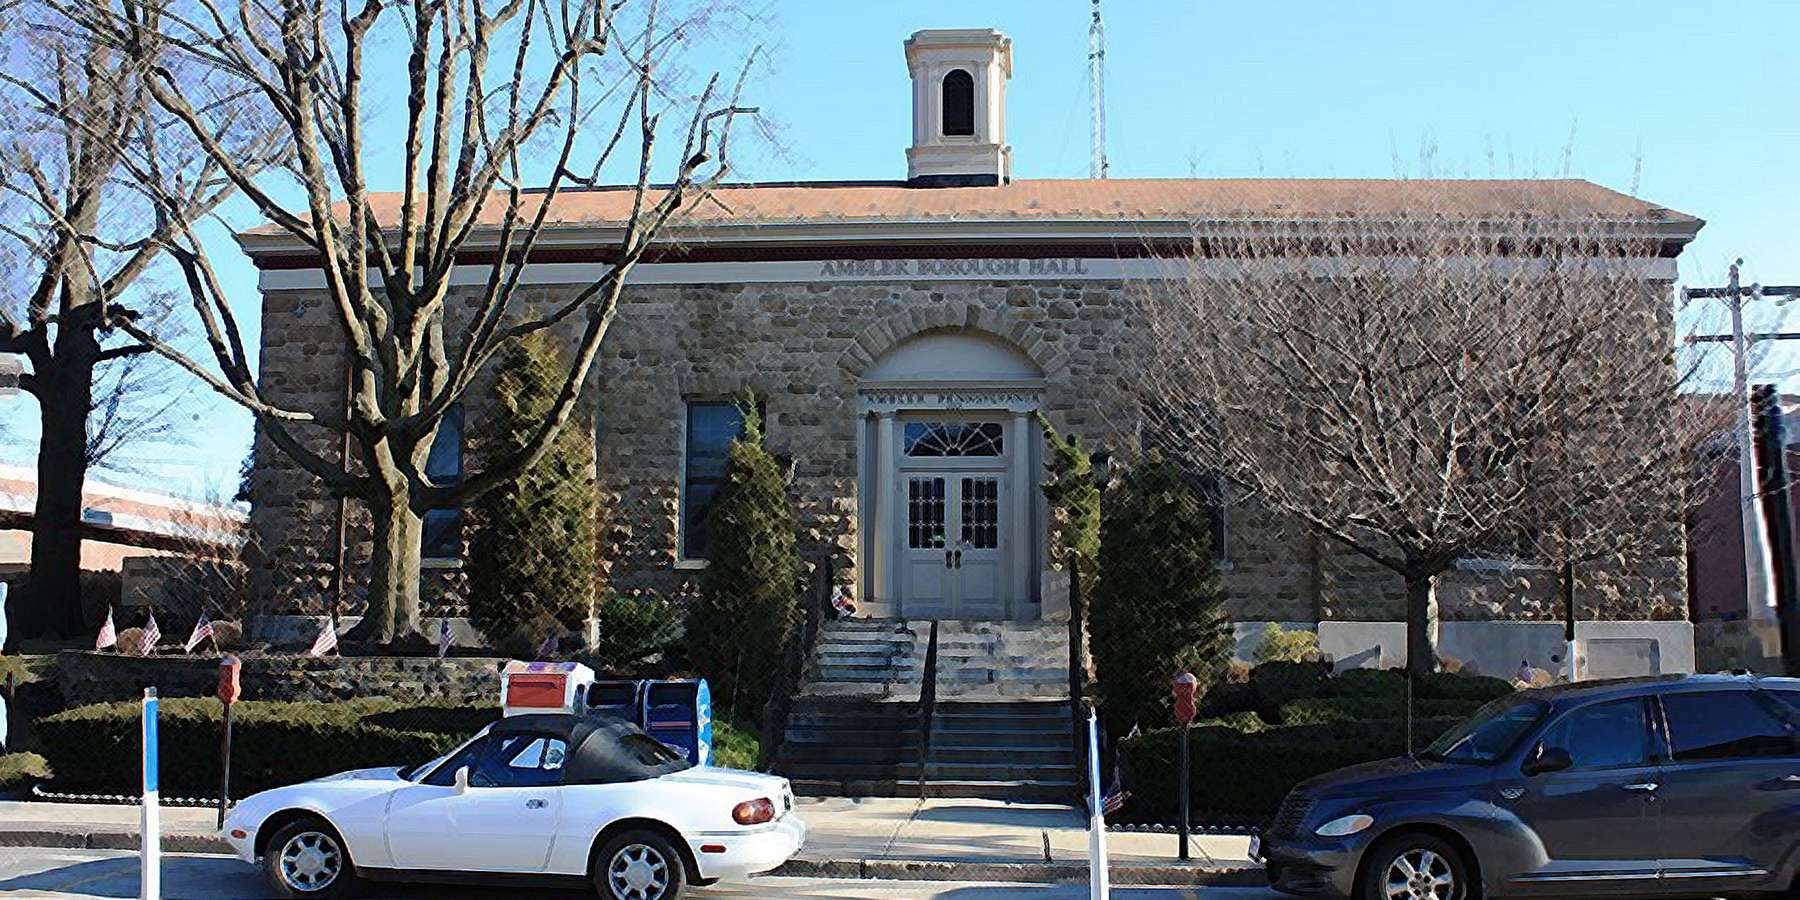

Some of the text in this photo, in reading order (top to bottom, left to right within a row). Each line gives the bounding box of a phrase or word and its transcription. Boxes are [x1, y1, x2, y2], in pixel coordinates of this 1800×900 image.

[820, 257, 1089, 277] AMBLER BOROUGH HALL
